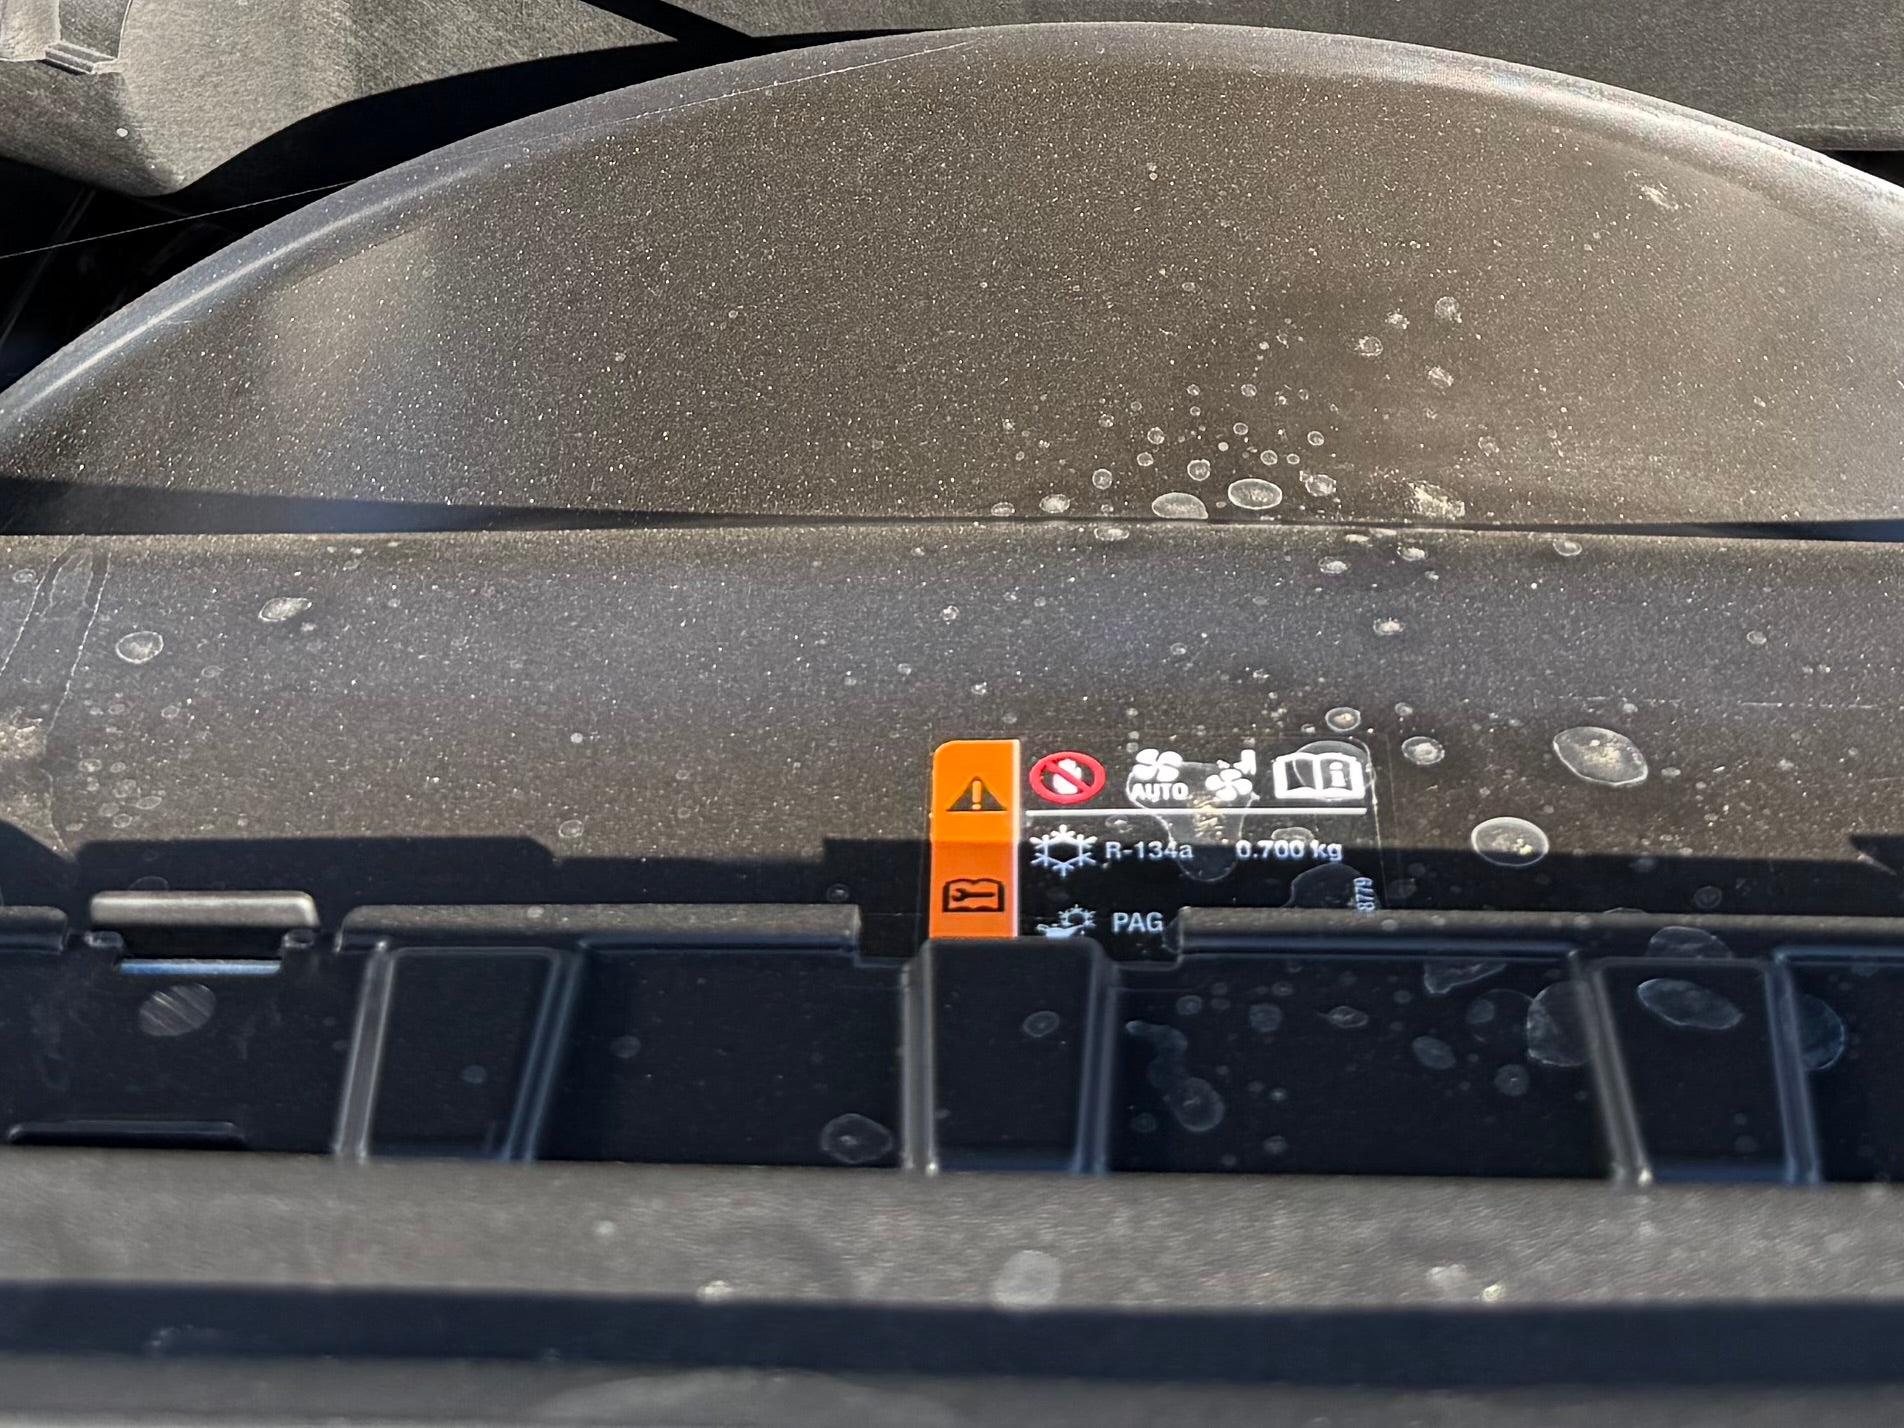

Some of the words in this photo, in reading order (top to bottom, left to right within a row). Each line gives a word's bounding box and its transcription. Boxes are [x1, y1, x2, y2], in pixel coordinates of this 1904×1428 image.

[1130, 782, 1189, 802] AUTO
[1105, 840, 1193, 859] R-134a
[1236, 840, 1304, 859] 0.700
[1311, 840, 1342, 861] kg
[1353, 877, 1375, 912] 8779
[1113, 912, 1163, 933] PAG
